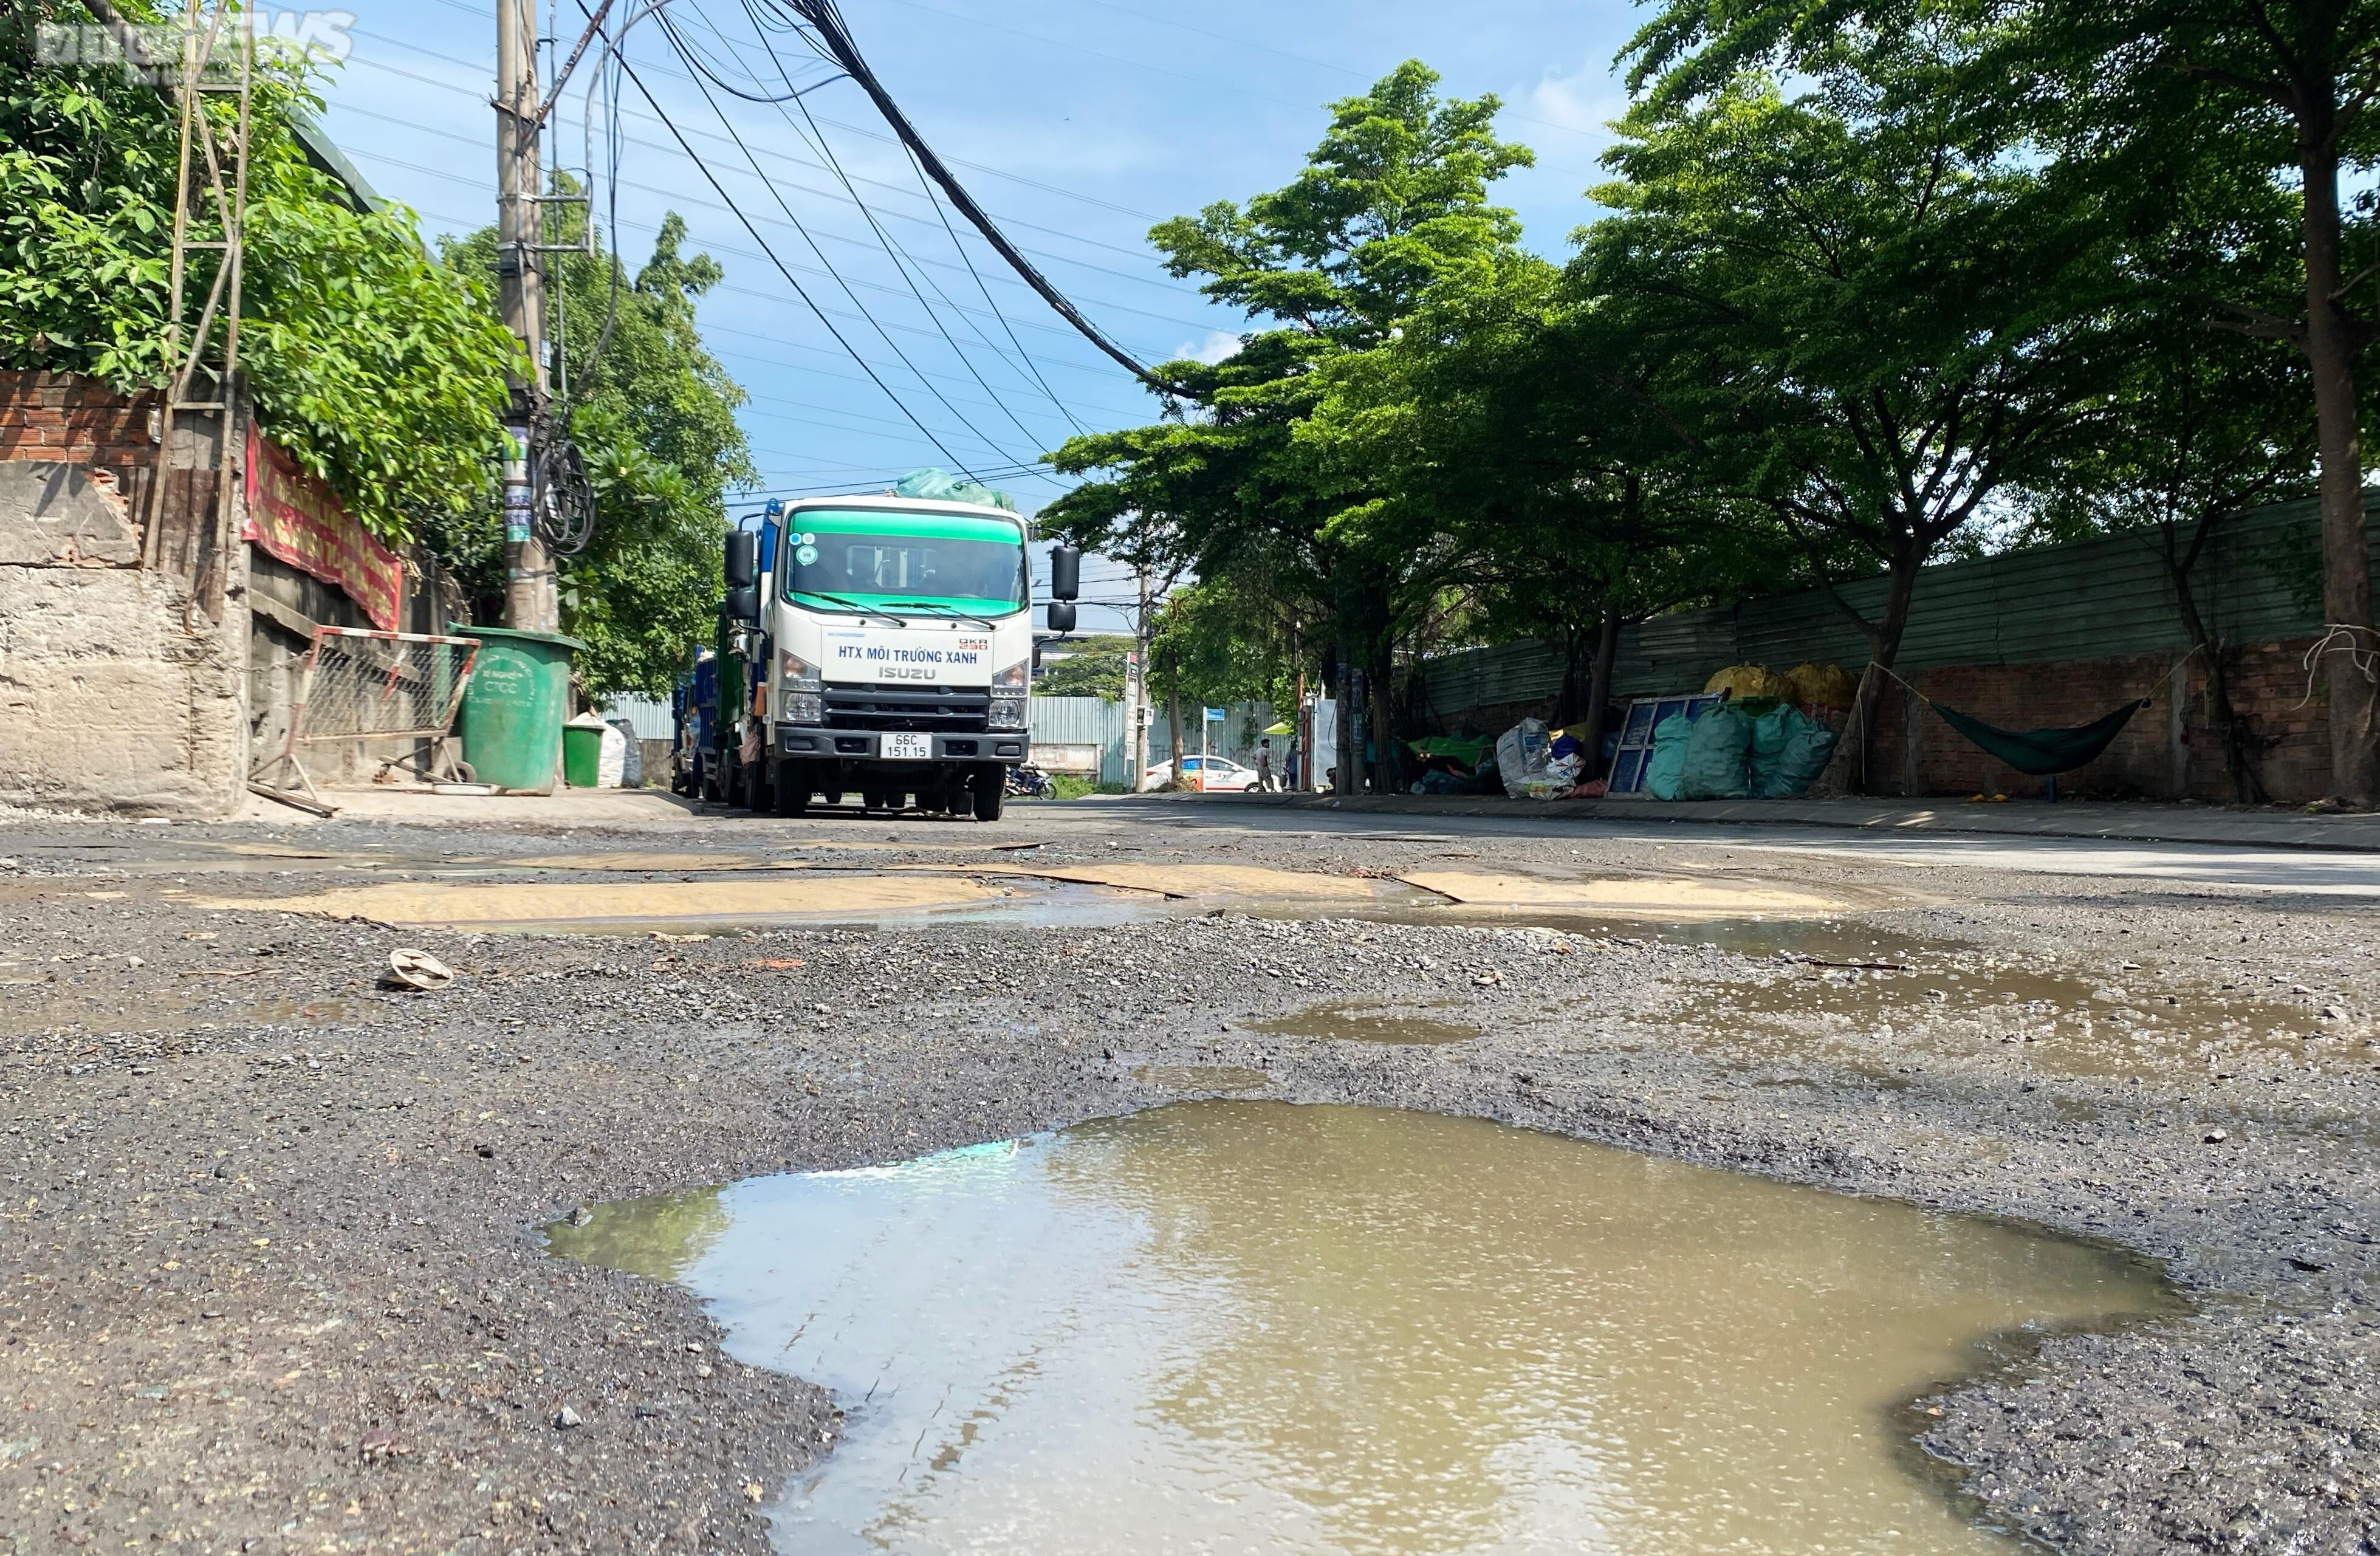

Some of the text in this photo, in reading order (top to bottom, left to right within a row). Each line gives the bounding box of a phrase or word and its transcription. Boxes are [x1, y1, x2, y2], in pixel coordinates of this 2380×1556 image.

[838, 645, 978, 664] HTX MÔI TRƯỜNG XANH
[879, 667, 936, 680] ISUZU
[896, 735, 917, 745] 66C
[888, 746, 927, 757] 151.15
